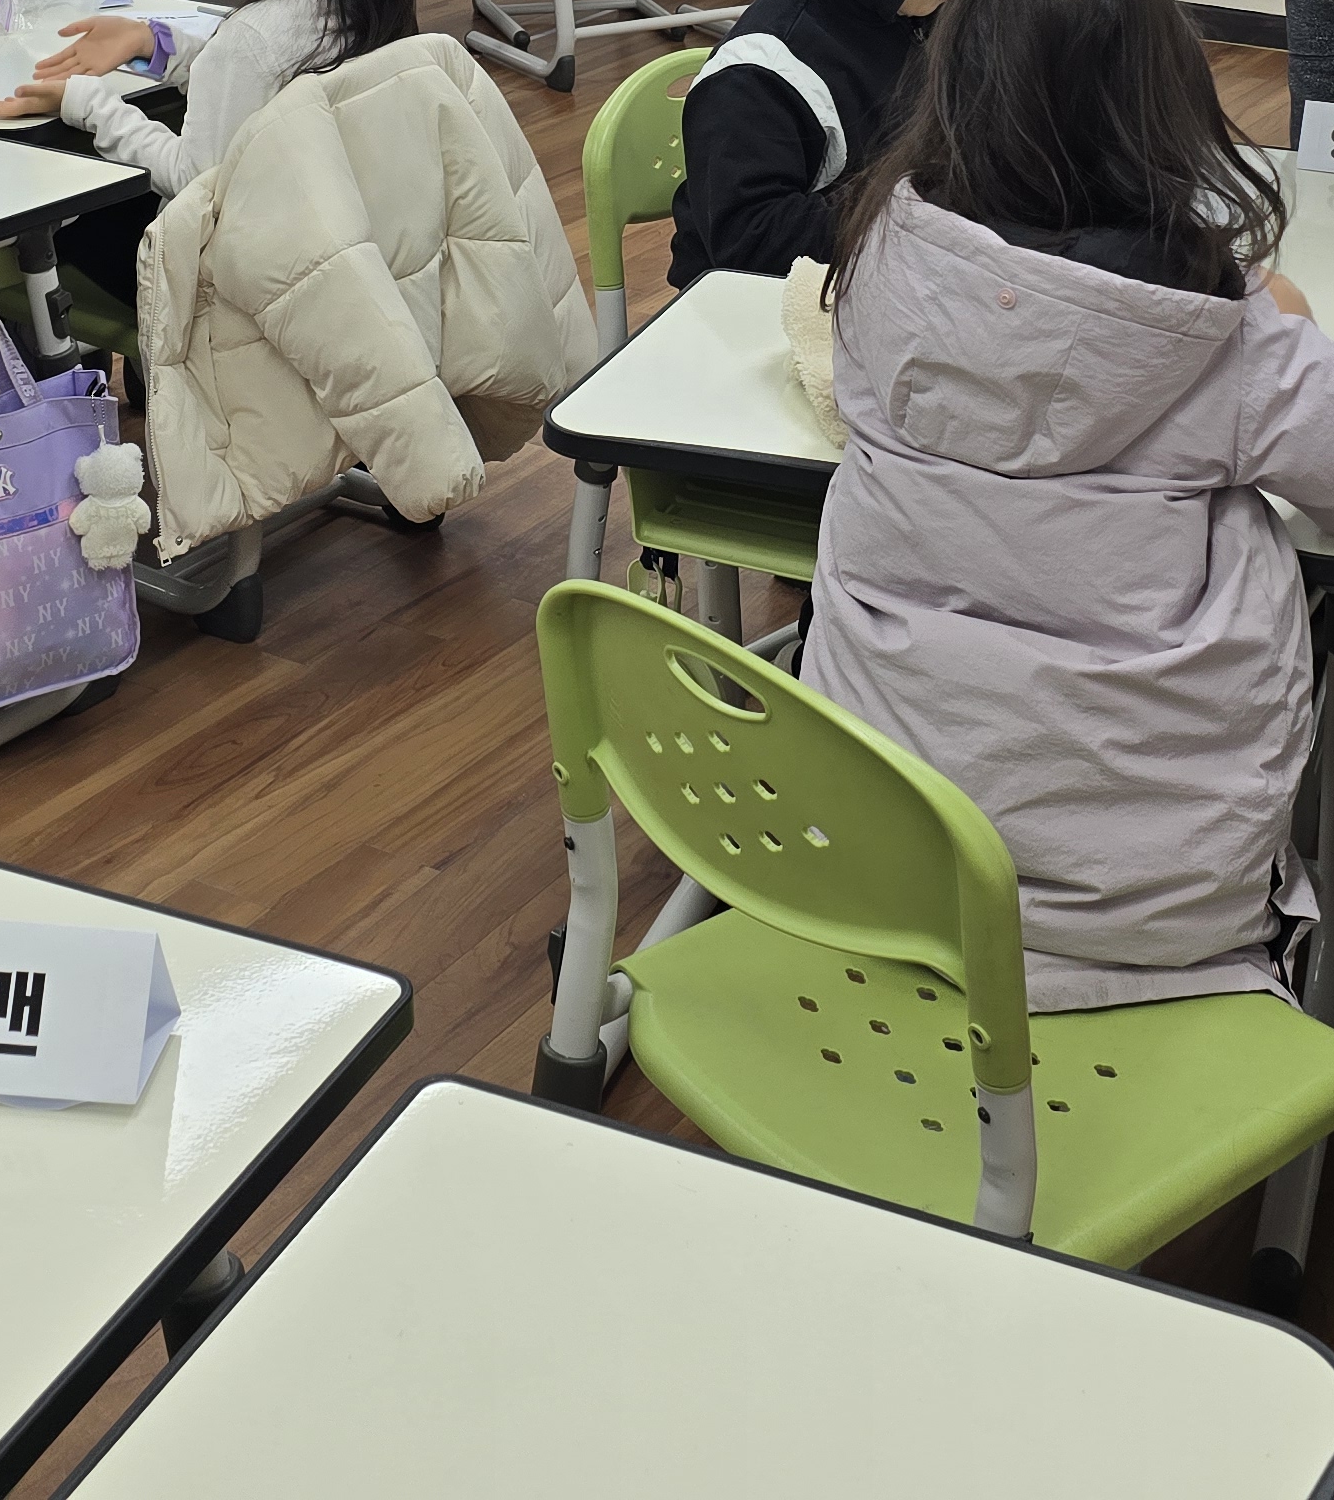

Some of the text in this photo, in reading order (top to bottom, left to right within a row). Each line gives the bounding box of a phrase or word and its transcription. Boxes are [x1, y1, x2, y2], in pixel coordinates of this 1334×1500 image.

[32, 547, 61, 574] NY
[0, 584, 30, 608] NY
[38, 598, 68, 624] NY
[77, 612, 105, 637] NY
[6, 634, 36, 658] NY
